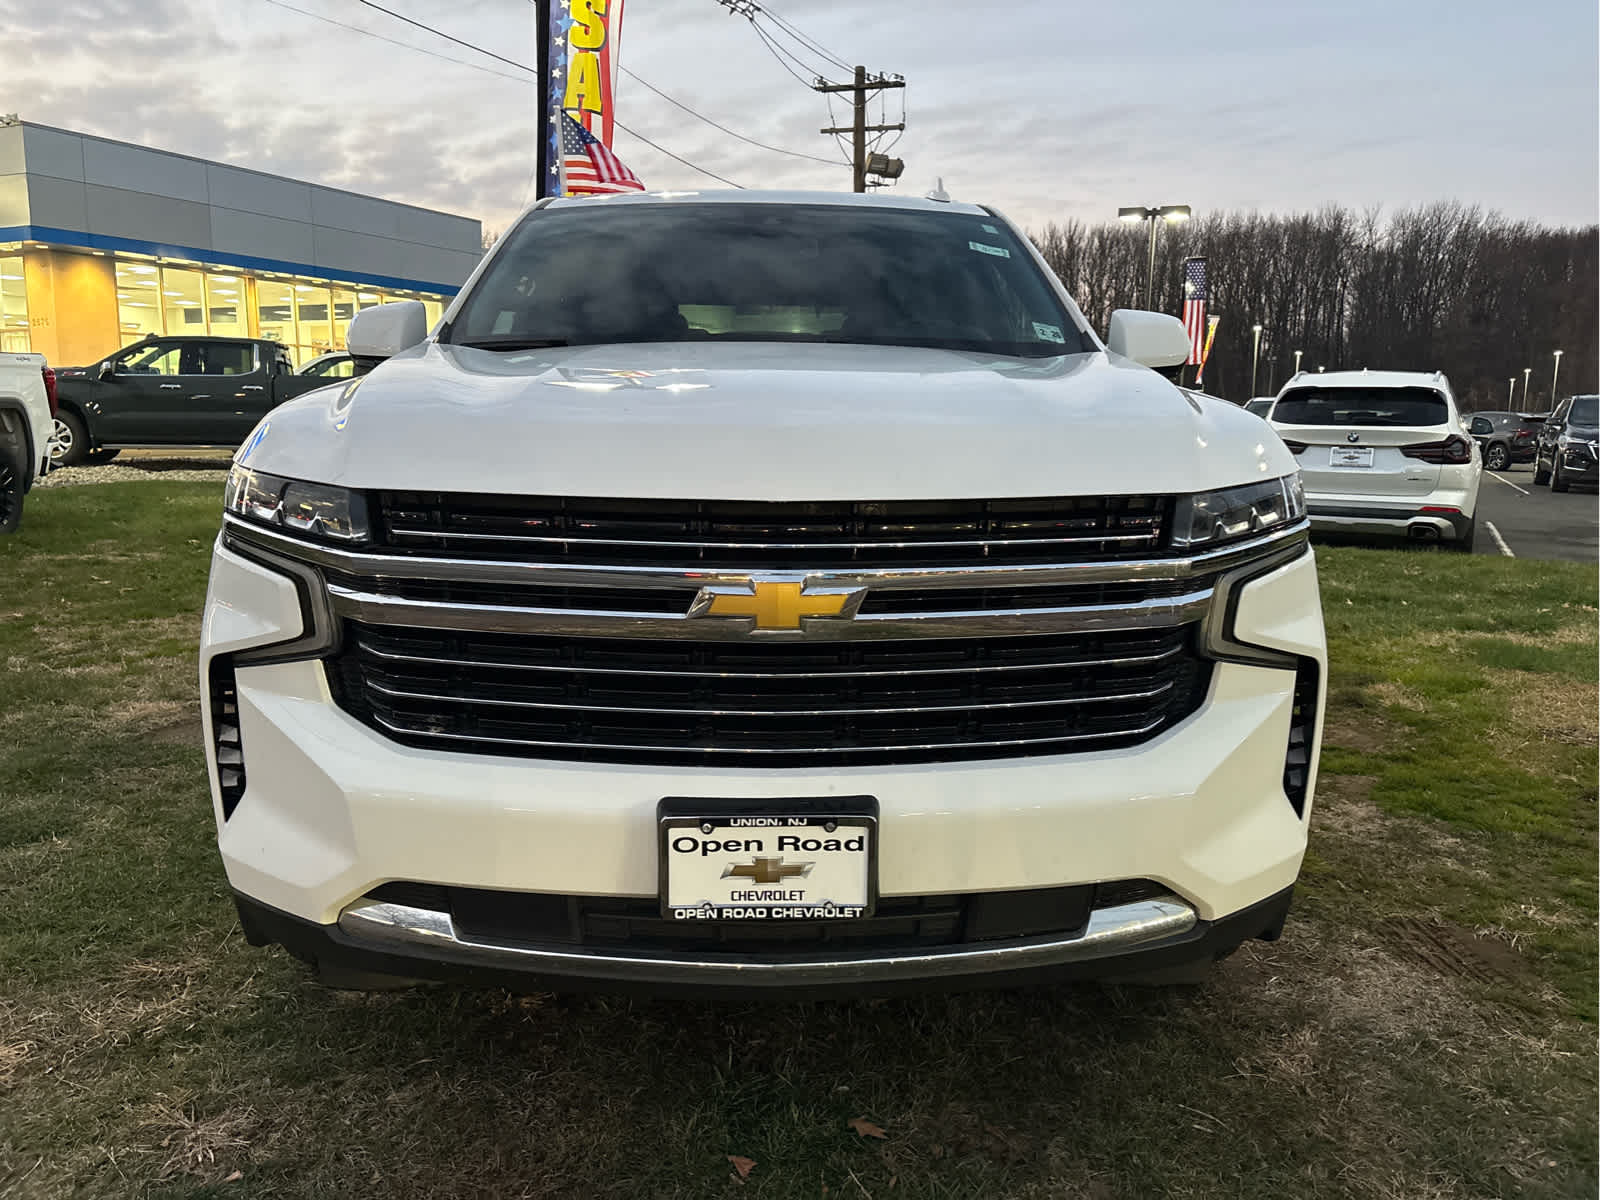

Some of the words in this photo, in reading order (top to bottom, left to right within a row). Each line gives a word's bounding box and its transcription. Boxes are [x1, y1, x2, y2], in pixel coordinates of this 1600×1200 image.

[788, 818, 808, 826] NJ
[672, 837, 763, 856] Open
[778, 836, 865, 852] Road
[730, 890, 805, 902] CHEVROLET
[674, 909, 718, 920] OPEN
[722, 908, 767, 919] ROAD
[772, 907, 863, 919] CHEVROLET
